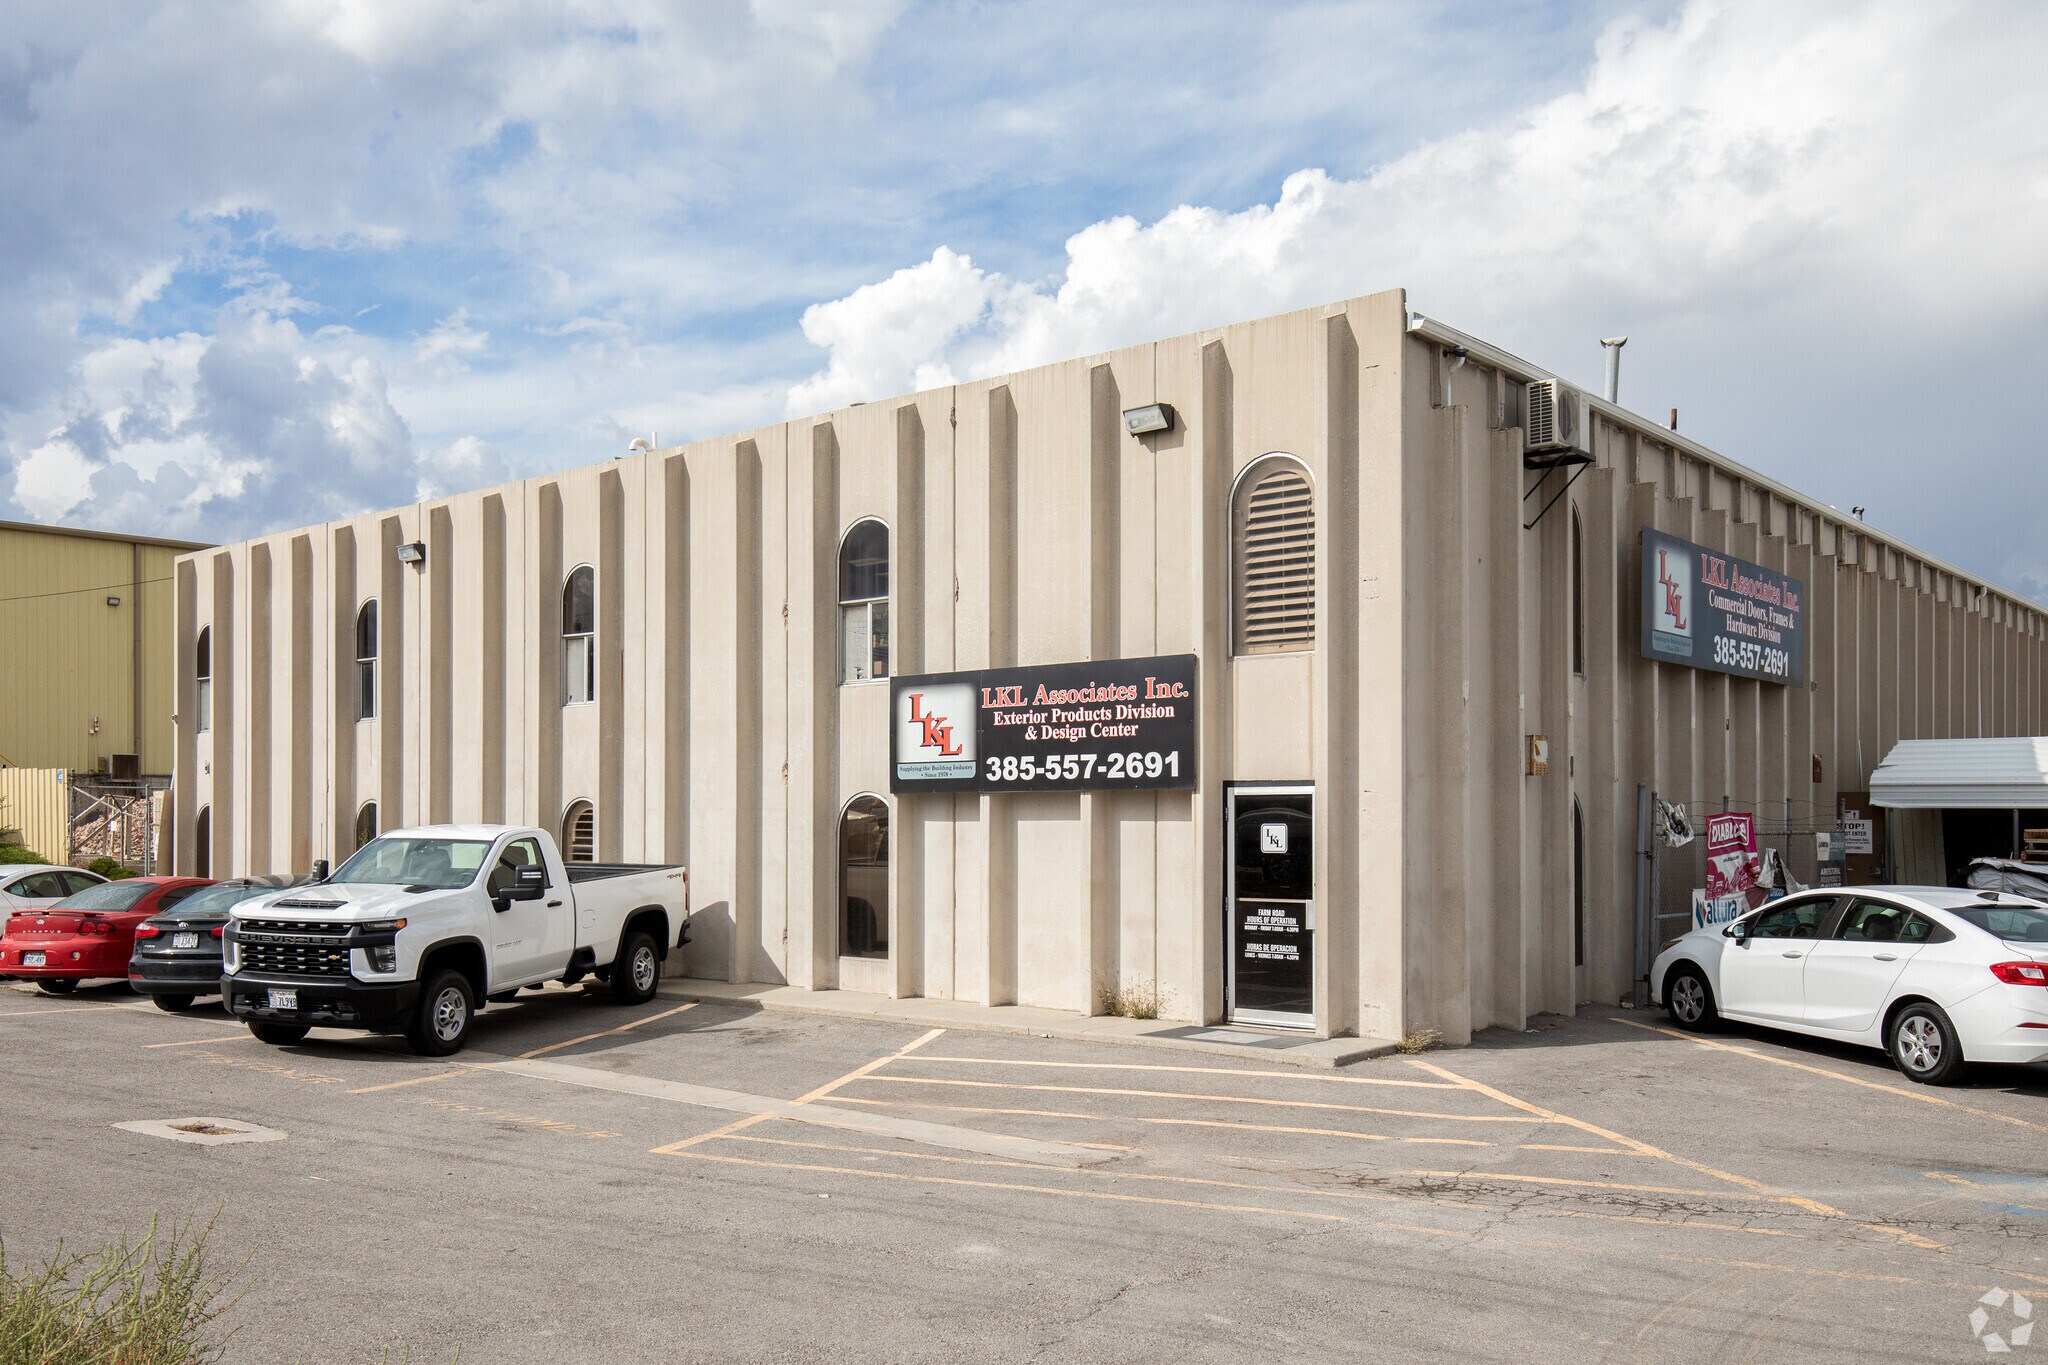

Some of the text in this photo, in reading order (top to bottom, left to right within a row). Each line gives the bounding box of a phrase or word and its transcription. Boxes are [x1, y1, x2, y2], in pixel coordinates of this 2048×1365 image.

[1659, 549, 1686, 630] LKL
[1702, 554, 1800, 612] LKL Associates Inc.
[1709, 589, 1794, 628] Commercial Doors, Frames &
[1726, 614, 1781, 644] Hardware Division
[1714, 634, 1788, 677] 385-557-2691
[982, 677, 1189, 708] LKL Associates Inc.
[908, 694, 962, 756] LKL
[993, 703, 1175, 726] Exterior Products Division
[1024, 722, 1138, 742] & Design Center
[986, 750, 1180, 782] 385-557-2691
[1266, 828, 1282, 848] LKL
[238, 934, 348, 945] CHEVROLET
[1270, 944, 1297, 952] OPERACION
